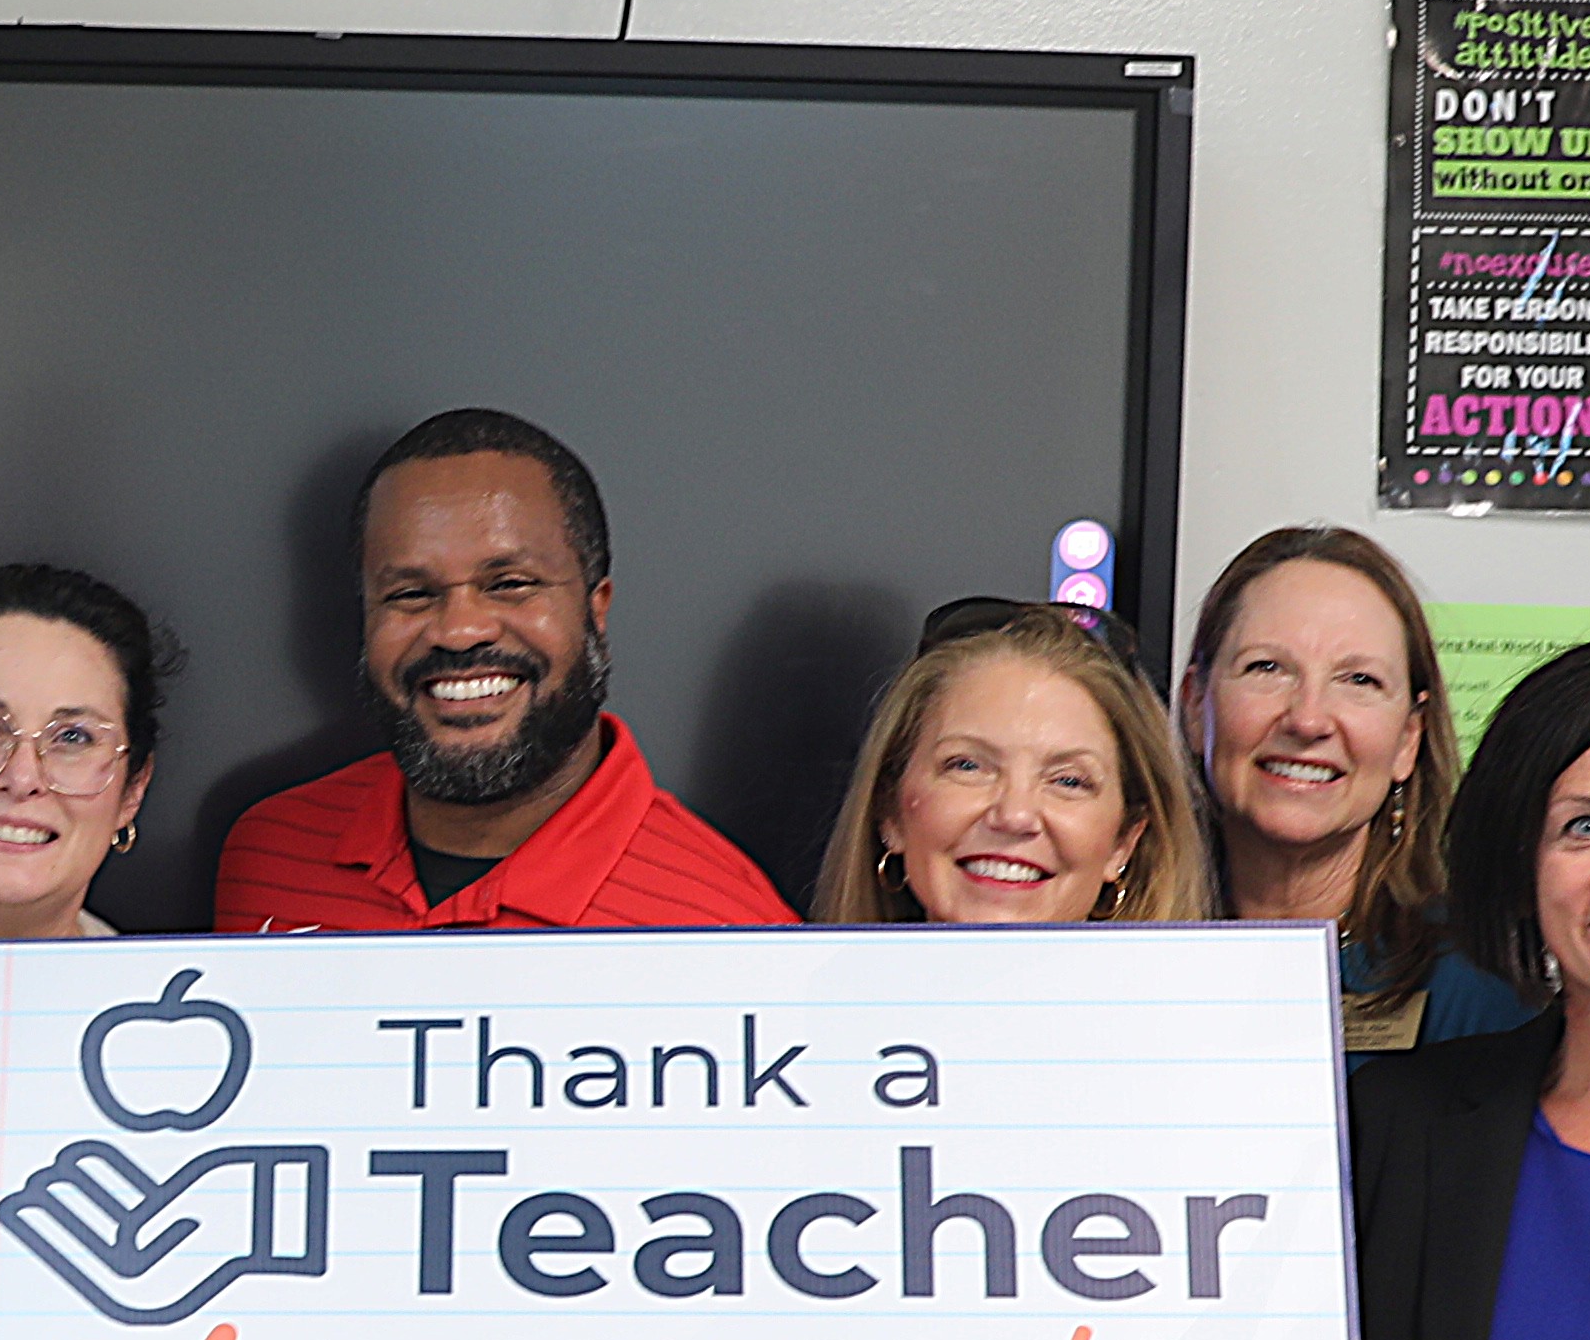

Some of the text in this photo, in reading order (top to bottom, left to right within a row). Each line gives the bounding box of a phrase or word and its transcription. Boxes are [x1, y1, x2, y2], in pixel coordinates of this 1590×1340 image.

[1435, 89, 1557, 123] DON'T
[1433, 127, 1554, 157] SHOW
[1439, 166, 1553, 193] without
[1429, 296, 1491, 320] TAKE
[1461, 365, 1585, 390] FOR YOUR
[378, 1013, 943, 1113] Thank a
[369, 1146, 1272, 1302] Teacher
